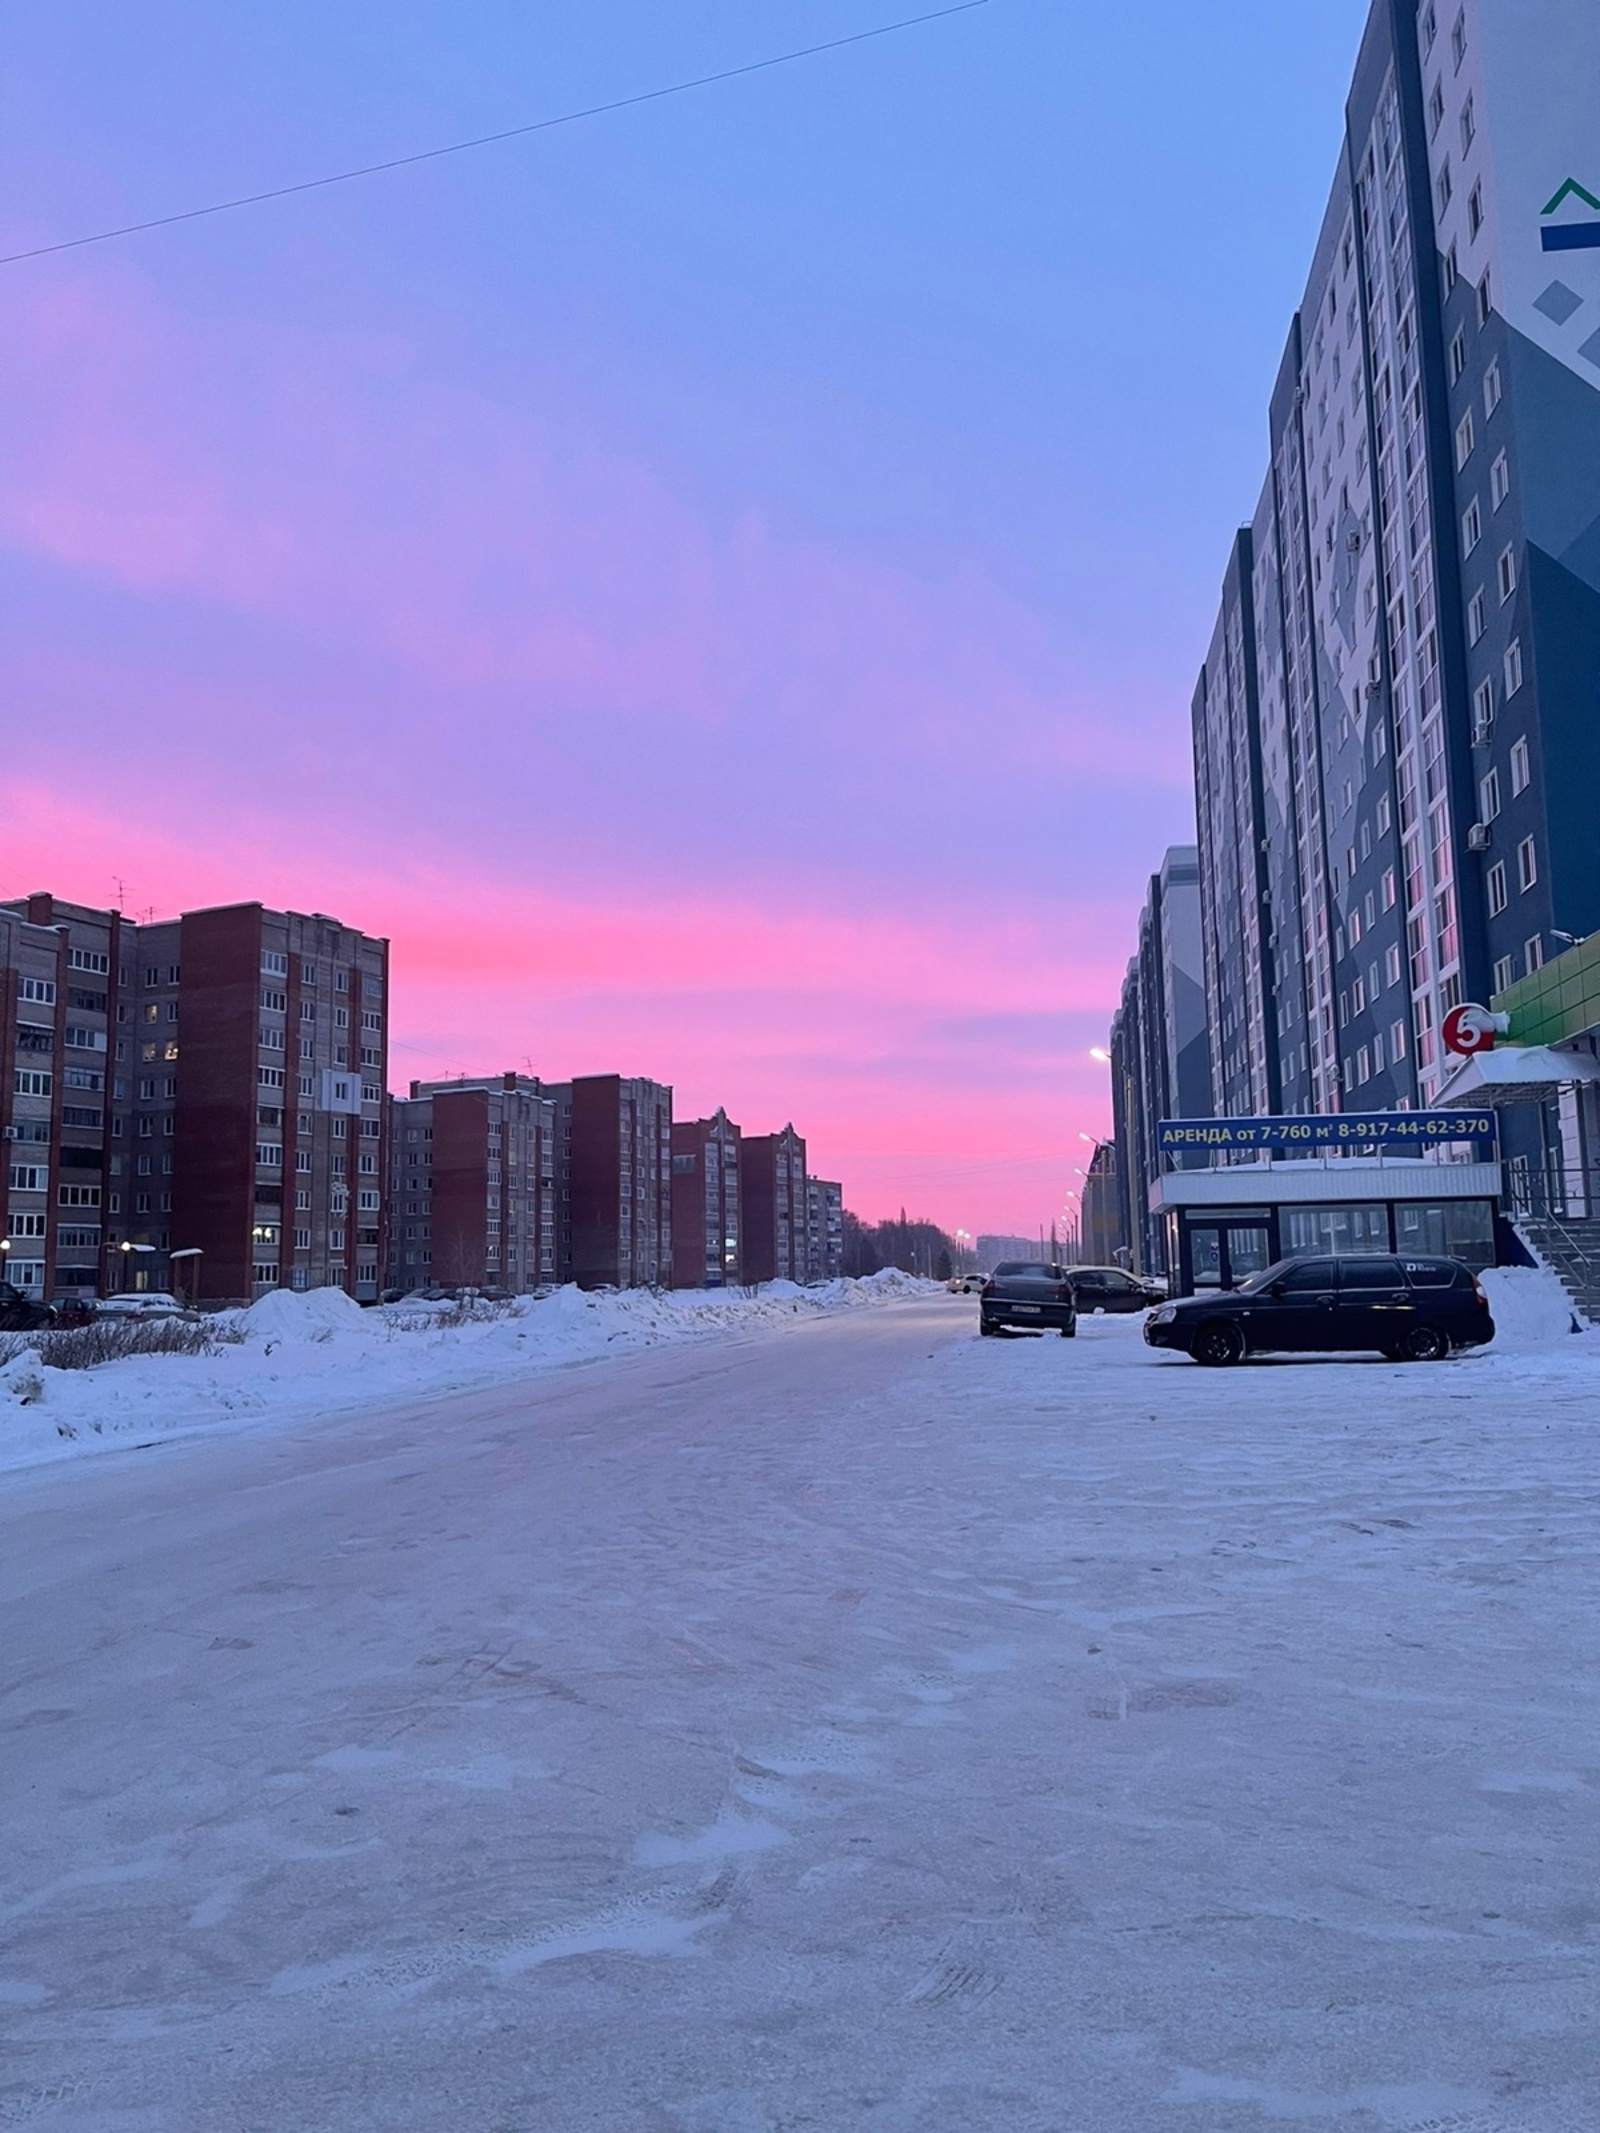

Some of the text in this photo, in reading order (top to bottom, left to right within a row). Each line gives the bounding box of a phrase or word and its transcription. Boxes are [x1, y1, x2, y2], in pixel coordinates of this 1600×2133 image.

[1163, 1128, 1232, 1143] АРЕНДА
[1236, 1128, 1256, 1139] от
[1261, 1124, 1311, 1139] 7-760
[1338, 1119, 1489, 1137] 8-917-44-62-370
